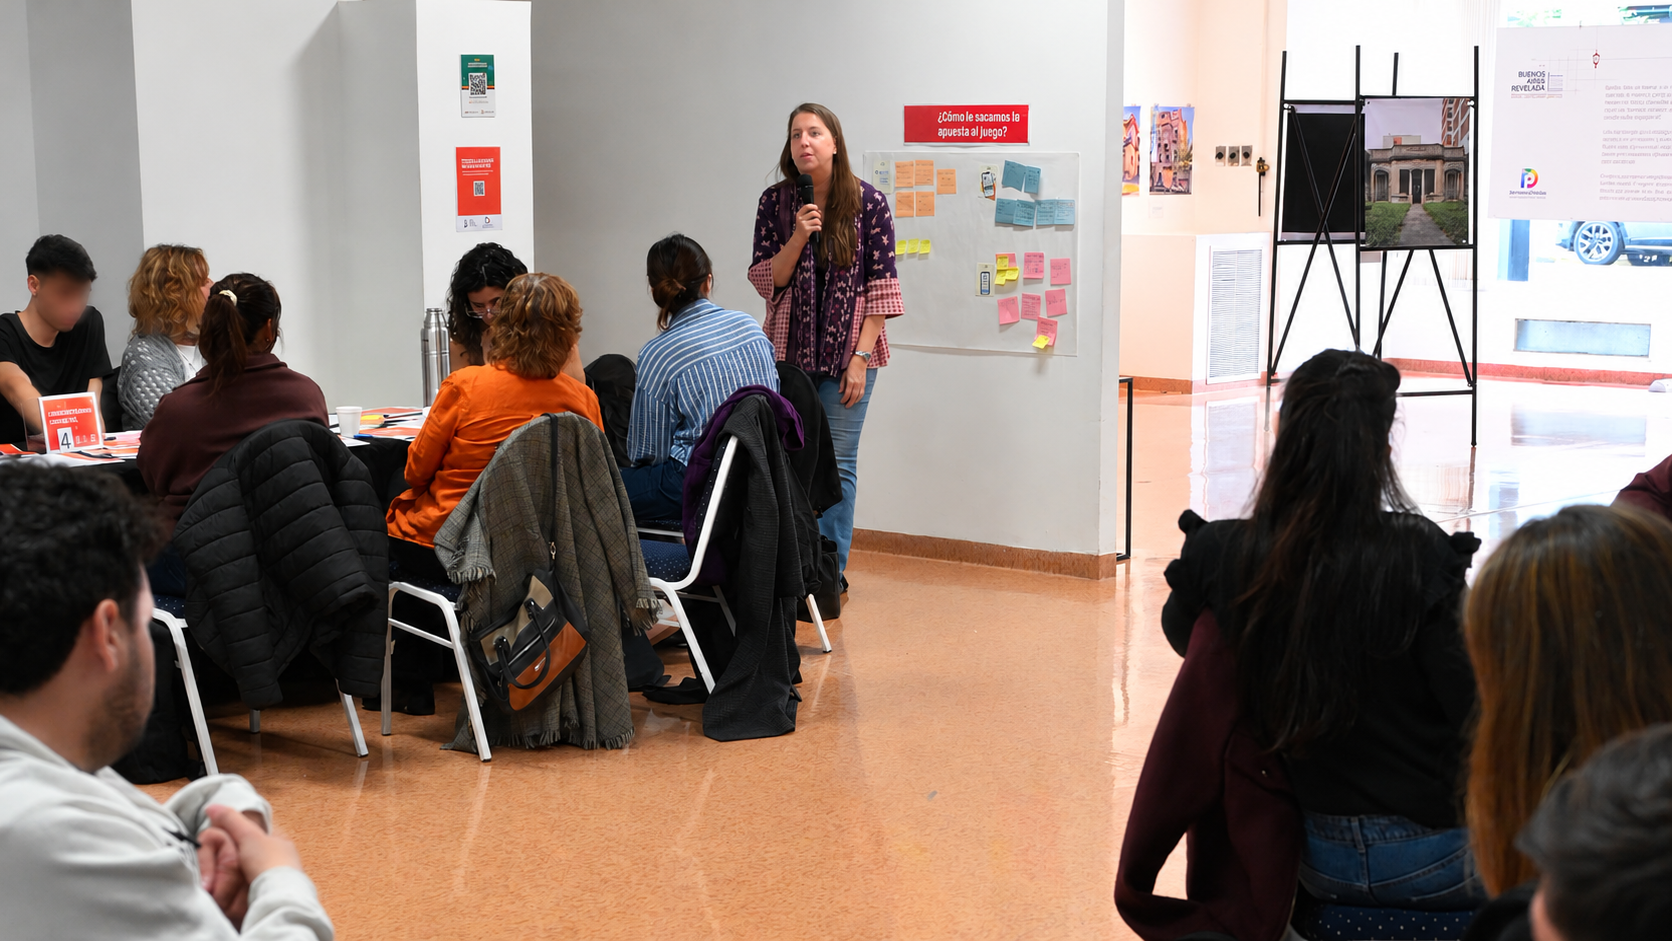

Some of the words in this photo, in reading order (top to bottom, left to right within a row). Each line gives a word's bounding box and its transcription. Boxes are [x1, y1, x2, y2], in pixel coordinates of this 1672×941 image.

[938, 111, 965, 123] ¿Cómo
[966, 111, 973, 122] le
[975, 113, 1010, 122] sacamos
[938, 126, 969, 138] apuesta
[971, 126, 978, 136] al
[980, 126, 1007, 139] juego?
[61, 432, 71, 449] 4
